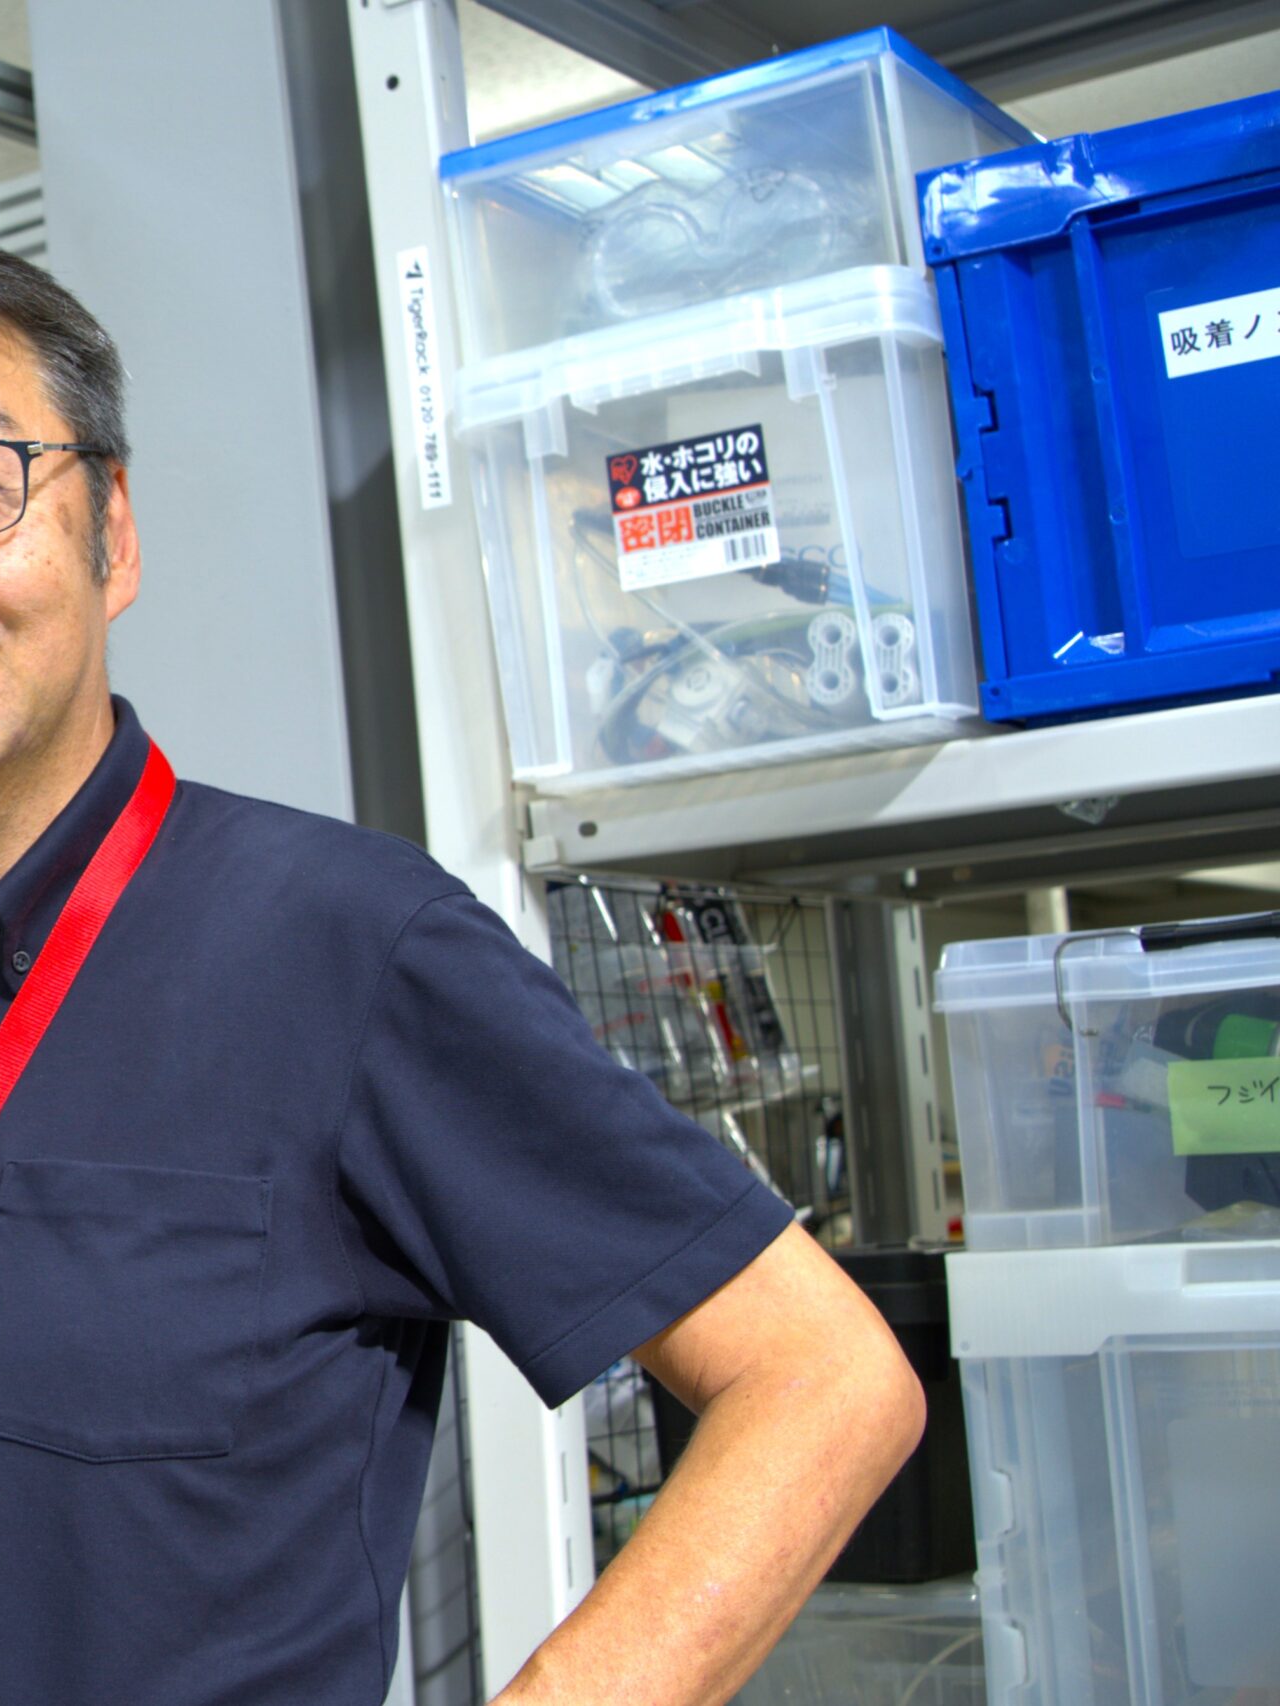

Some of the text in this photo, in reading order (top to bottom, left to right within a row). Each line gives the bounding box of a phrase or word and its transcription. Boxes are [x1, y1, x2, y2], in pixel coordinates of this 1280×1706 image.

[1170, 311, 1280, 356] 吸着ノ
[407, 287, 442, 499] TigerRack 0120-789-111
[642, 458, 763, 503] 侵入に強い
[693, 493, 745, 518] BUCKLE
[695, 511, 771, 540] CONTAINER
[619, 506, 695, 553] 密閉
